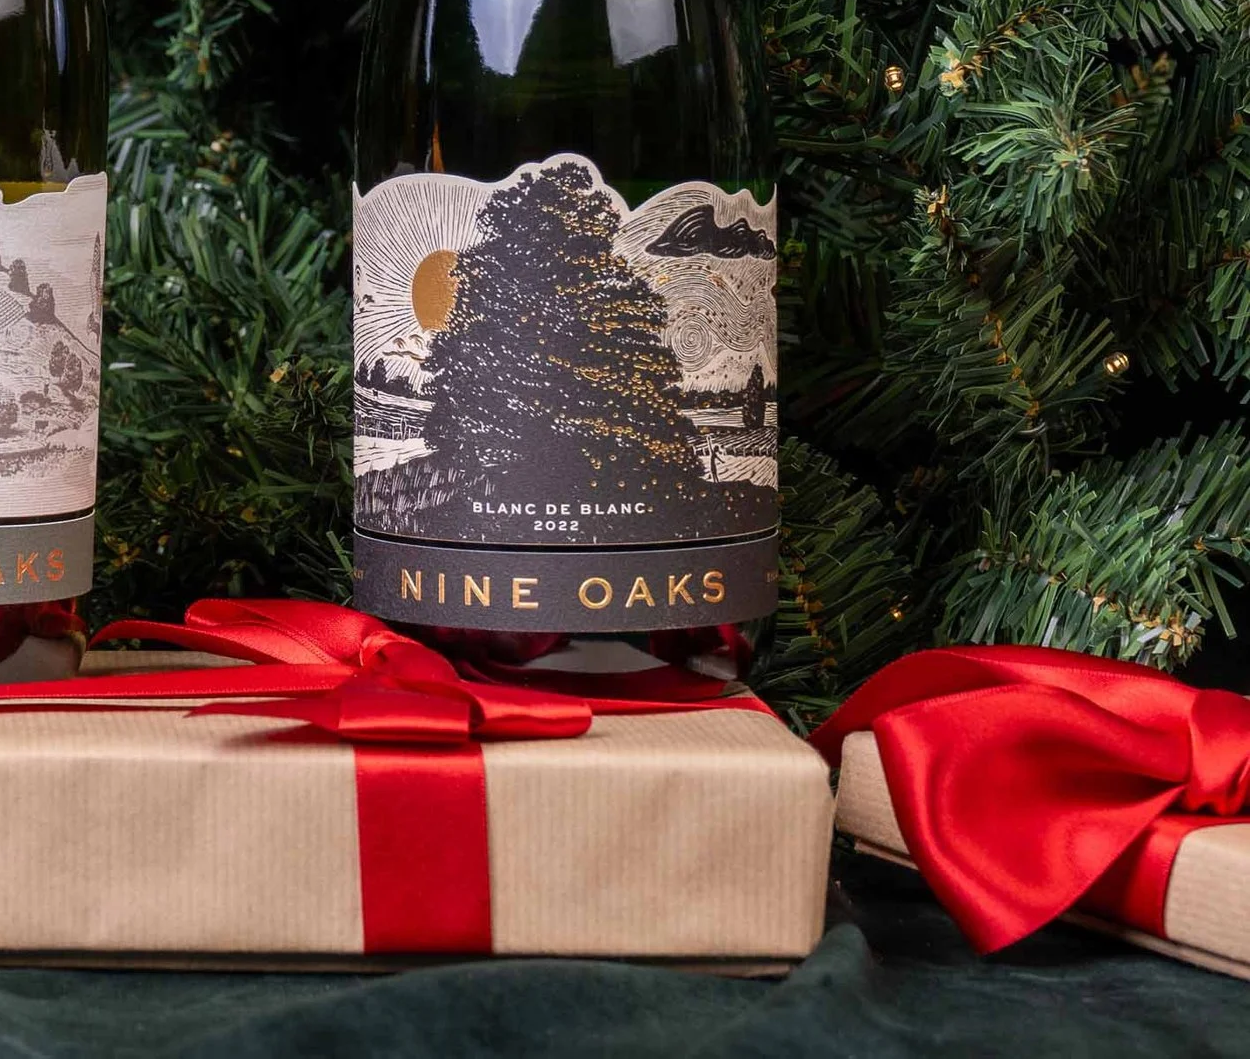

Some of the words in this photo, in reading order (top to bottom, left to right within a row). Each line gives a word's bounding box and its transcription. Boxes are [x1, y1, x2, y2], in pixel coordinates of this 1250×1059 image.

[472, 502, 537, 515] BLANC
[546, 503, 571, 515] DE
[533, 520, 579, 531] 2022
[400, 567, 539, 610] NINE
[578, 569, 726, 611] OAKS
